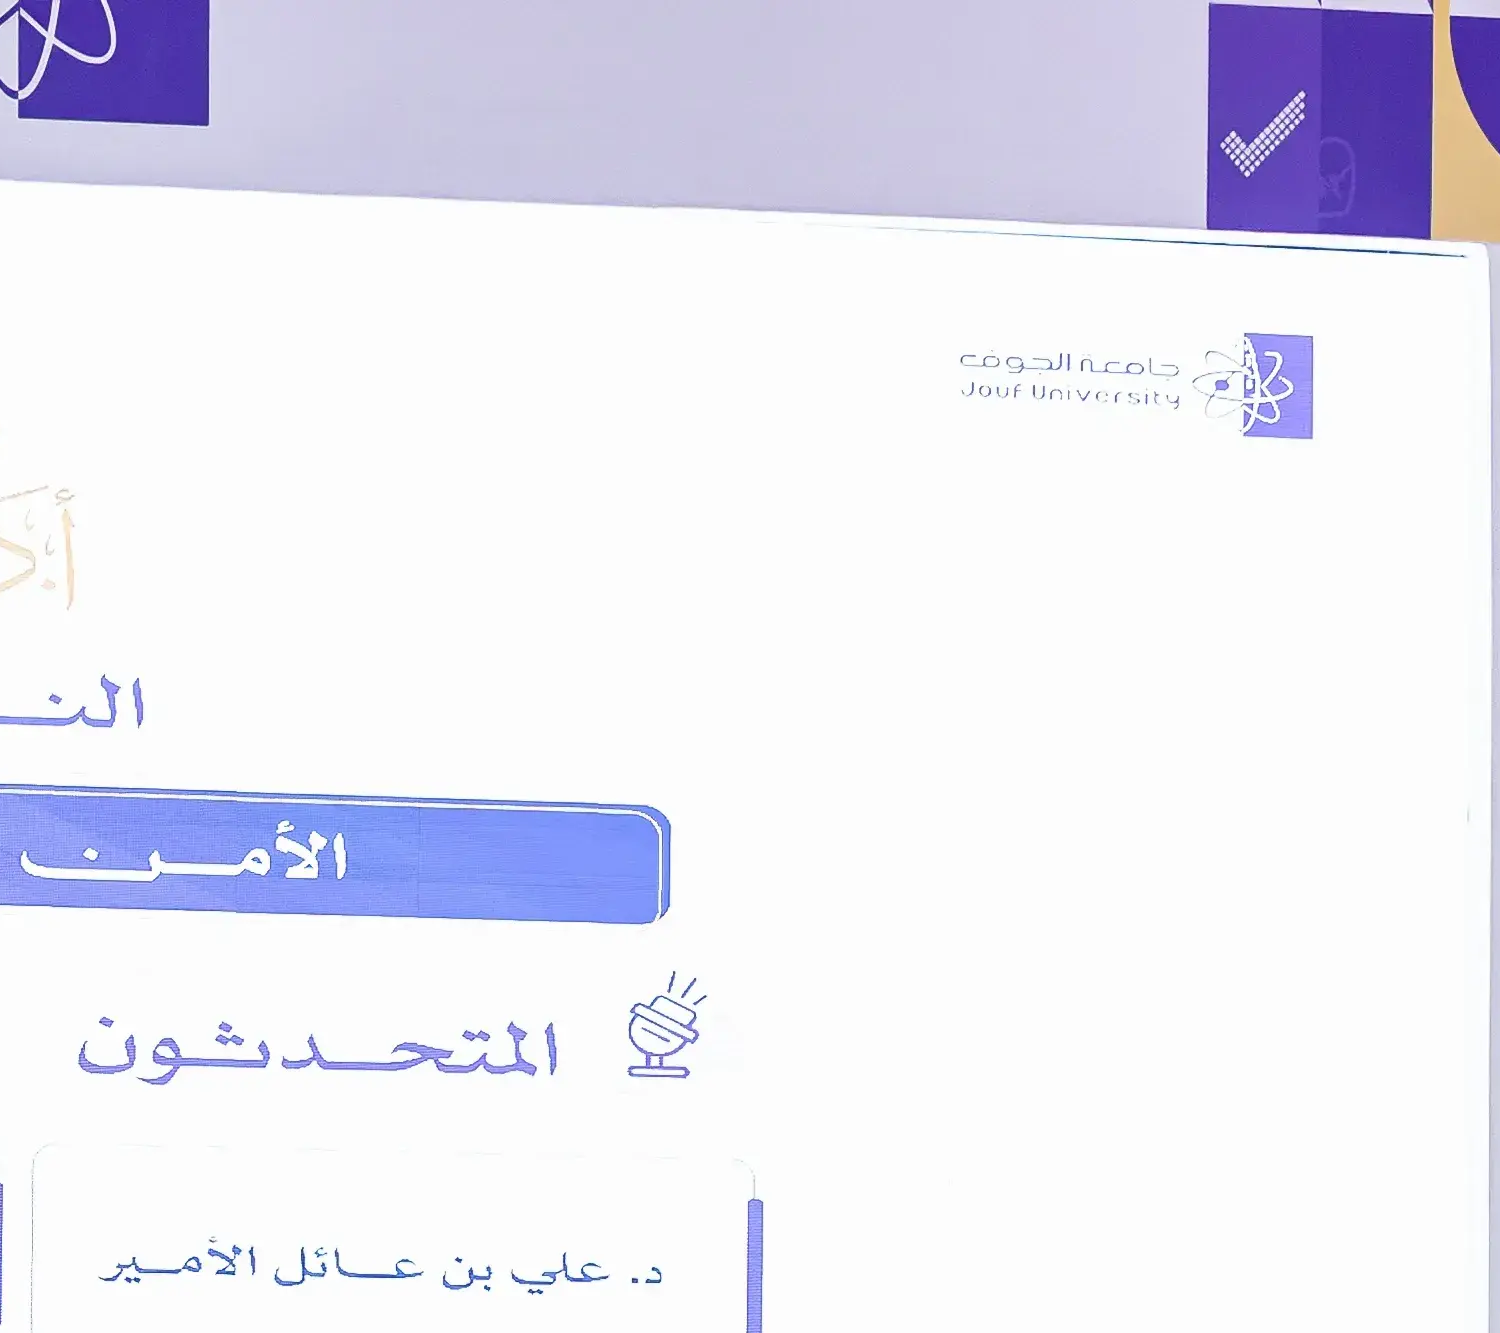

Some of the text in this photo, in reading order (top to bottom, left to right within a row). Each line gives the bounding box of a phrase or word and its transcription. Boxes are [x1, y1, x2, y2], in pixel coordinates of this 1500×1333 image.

[959, 349, 1181, 381] جامعة الجوف
[960, 381, 1181, 410] Jouf University
[20, 820, 347, 882] الأمن
[77, 1016, 559, 1087] المتحدثون
[97, 1235, 257, 1285] الأمير
[273, 1246, 426, 1287] عائل
[442, 1256, 495, 1293] بن
[510, 1251, 612, 1296] علي
